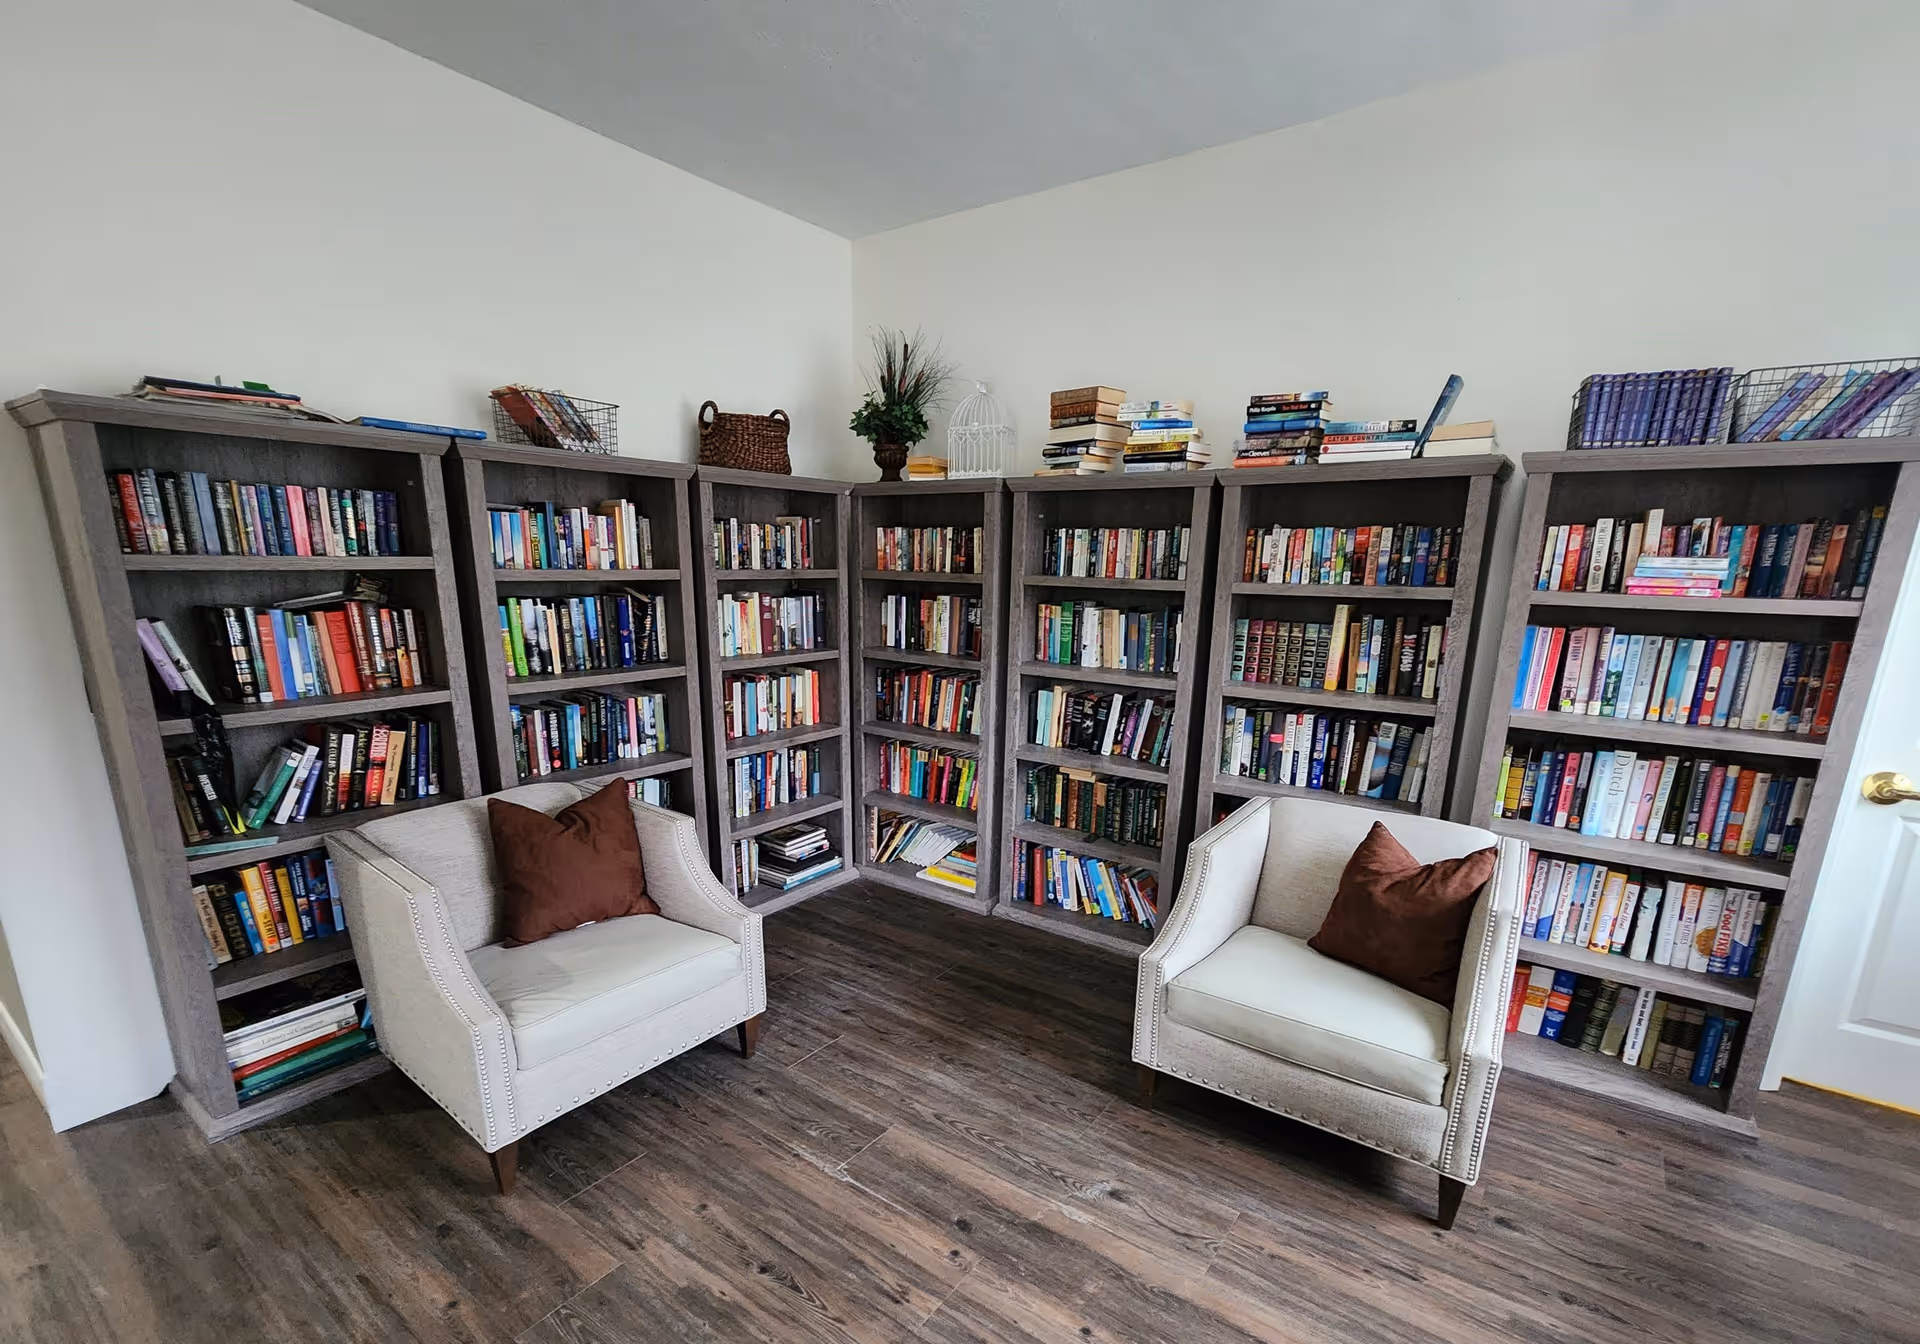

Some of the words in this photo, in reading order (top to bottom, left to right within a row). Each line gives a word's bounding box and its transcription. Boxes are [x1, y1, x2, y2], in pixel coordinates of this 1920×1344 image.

[357, 730, 368, 748] Jackie
[328, 748, 338, 768] COLLINS
[1302, 746, 1310, 774] POWELL
[1608, 755, 1632, 796] Dutch
[198, 774, 218, 800] AVENGED
[1536, 866, 1546, 888] Kitchen
[1564, 870, 1574, 893] Kitchen
[1532, 890, 1540, 905] Table
[1560, 894, 1568, 910] Table
[1626, 891, 1636, 902] Eat
[1528, 907, 1538, 922] Book
[1622, 903, 1631, 914] and
[1618, 914, 1629, 930] Heal
[1720, 908, 1737, 930] Food
[1680, 916, 1694, 945] REMEDIES
